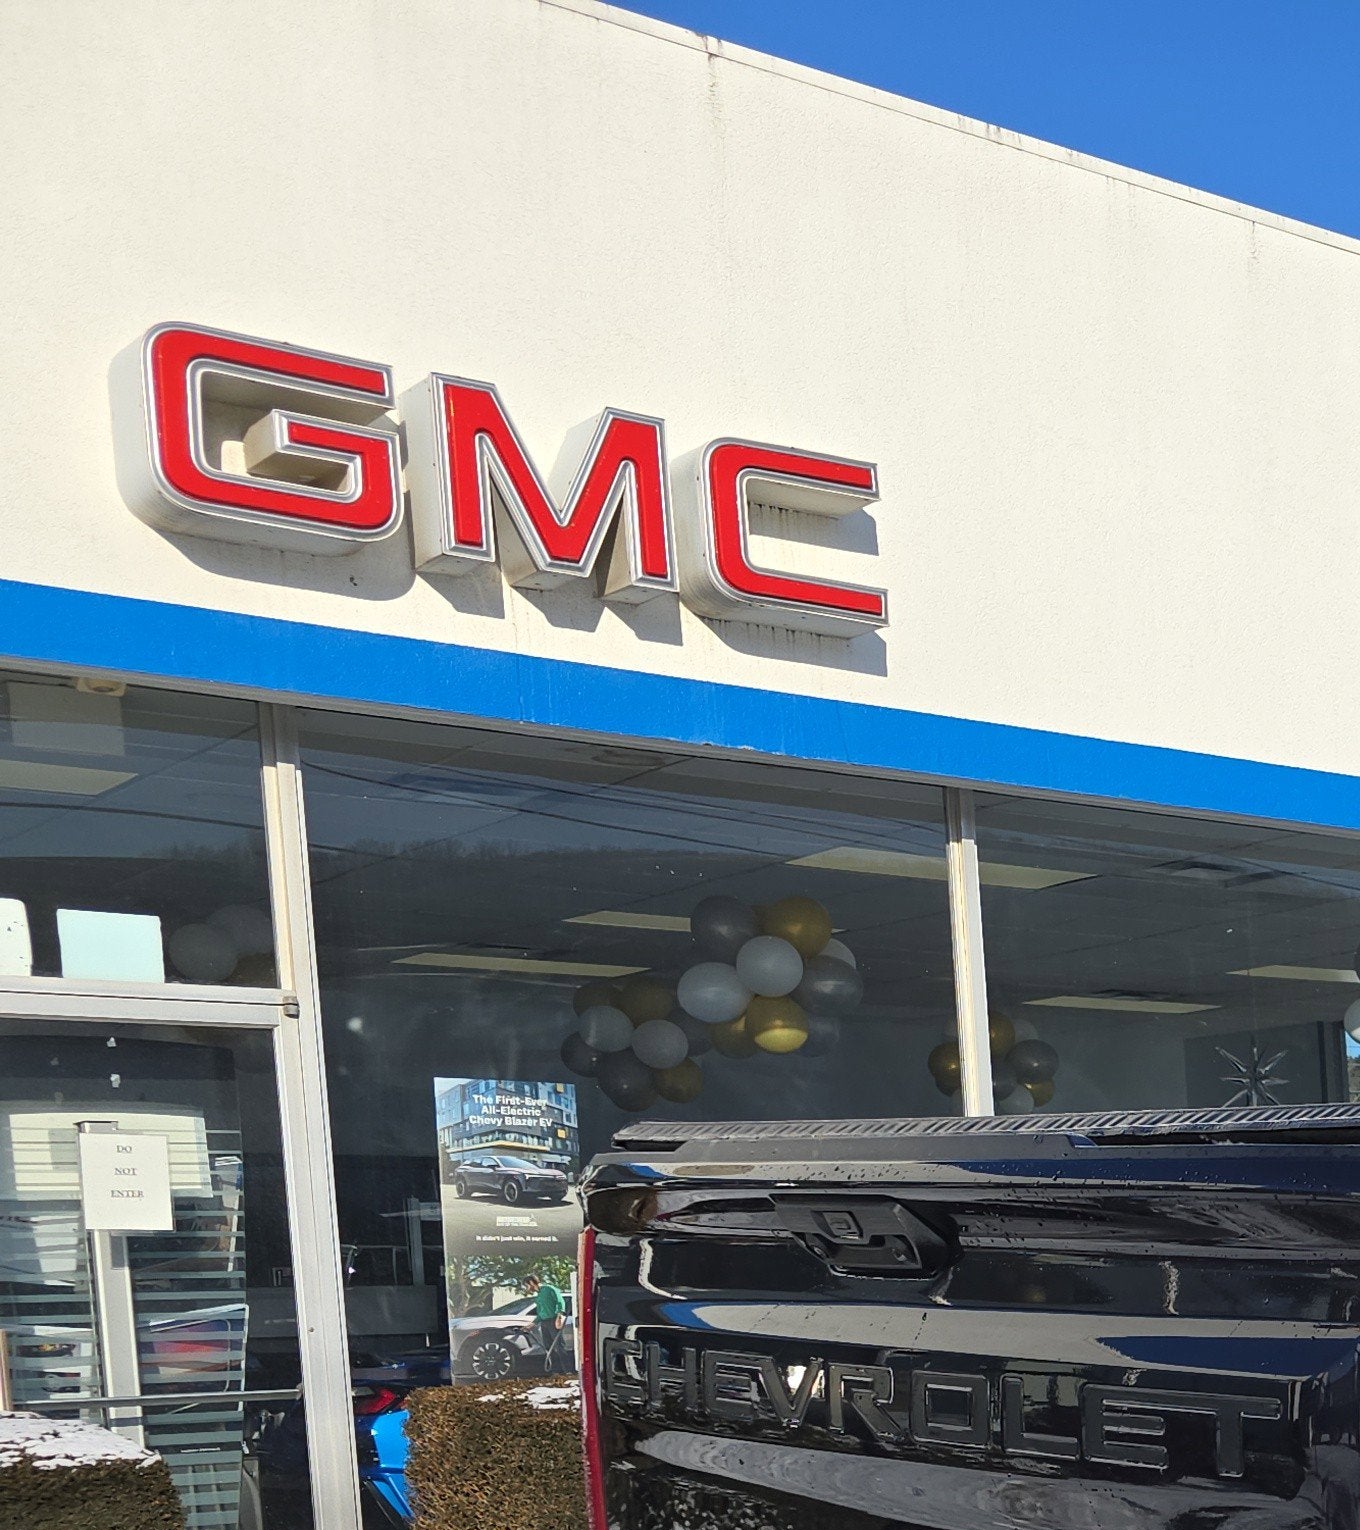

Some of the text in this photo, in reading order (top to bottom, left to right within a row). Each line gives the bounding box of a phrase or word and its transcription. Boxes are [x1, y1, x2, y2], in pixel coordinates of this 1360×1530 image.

[138, 321, 890, 630] GMC
[473, 1094, 548, 1107] The First-Ever
[481, 1105, 542, 1117] All-Electric
[469, 1115, 553, 1128] Chevy Blazer EV
[116, 1145, 132, 1154] DO
[114, 1167, 137, 1176] NOT
[111, 1189, 144, 1198] ENTER
[601, 1338, 1281, 1478] CHEVROLET
